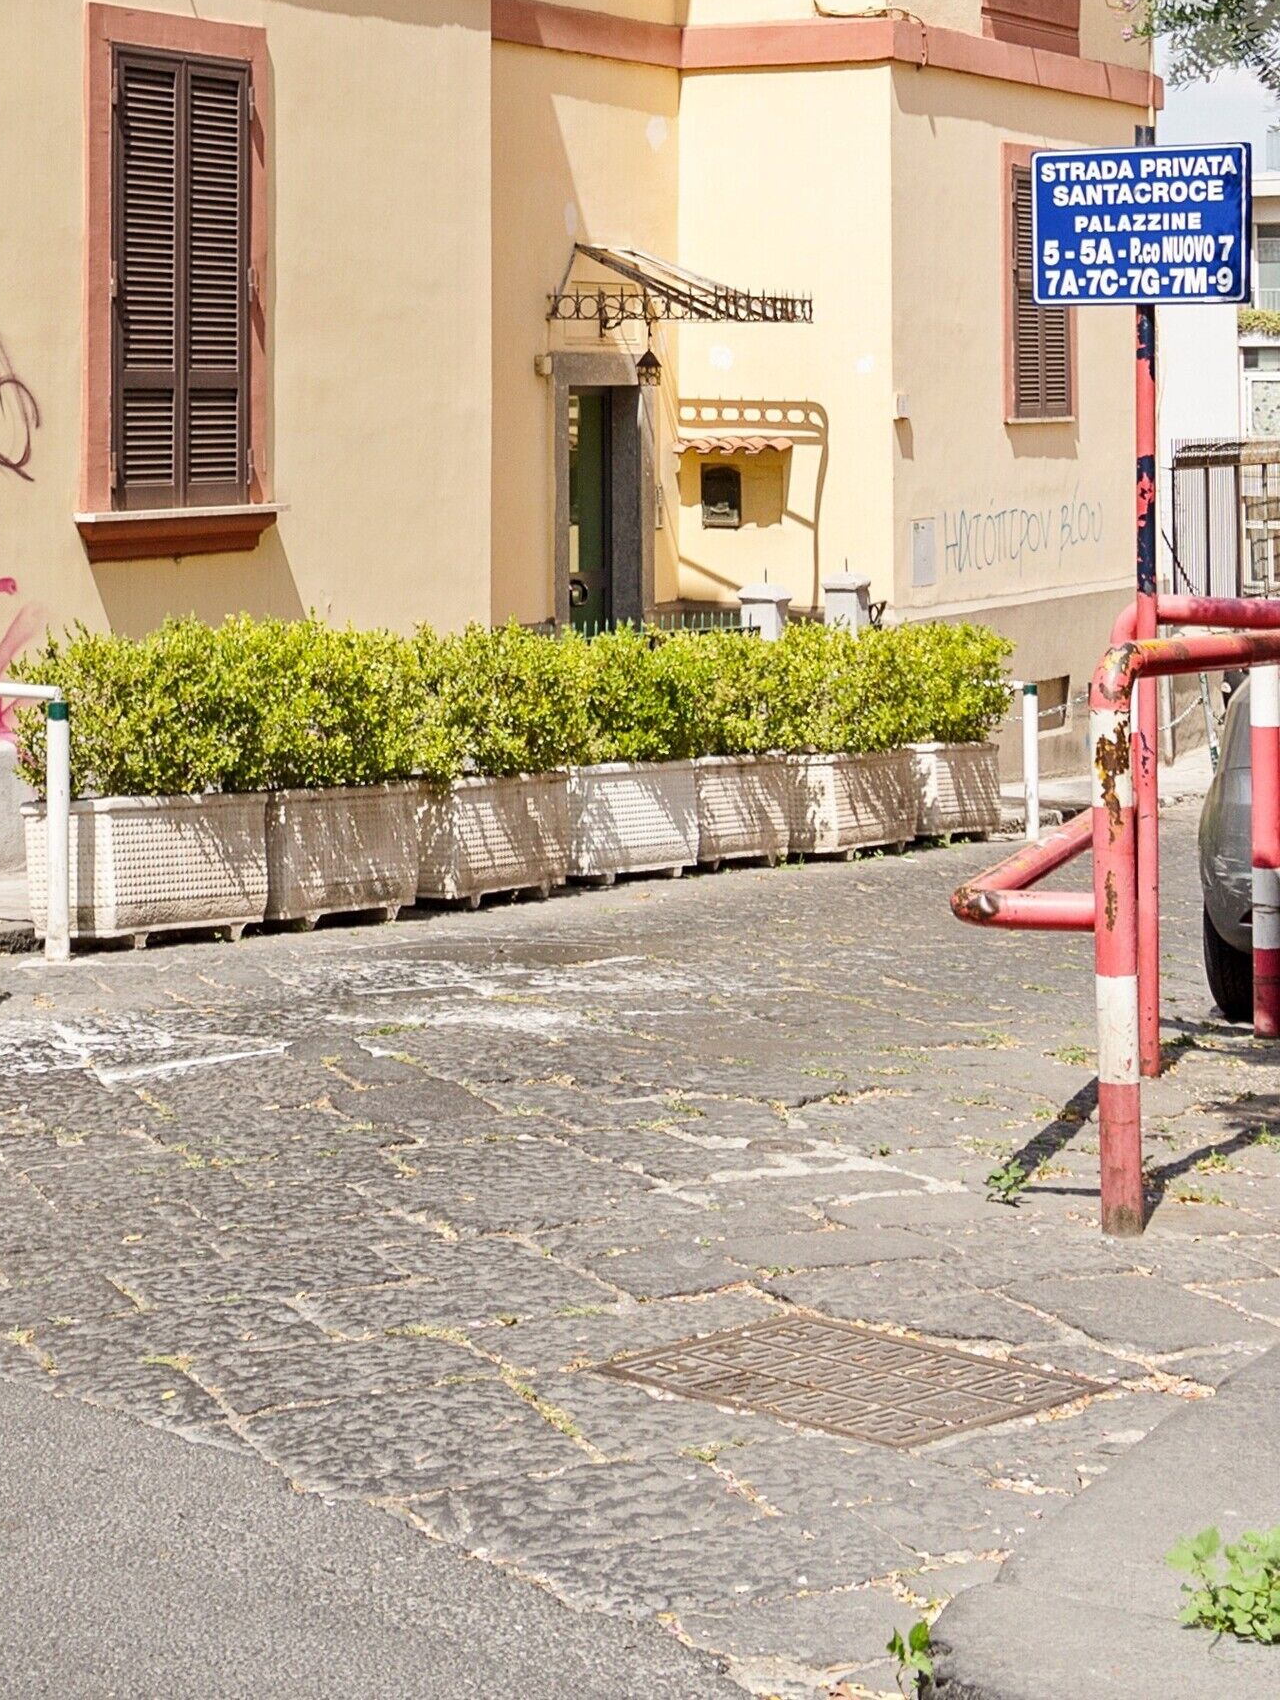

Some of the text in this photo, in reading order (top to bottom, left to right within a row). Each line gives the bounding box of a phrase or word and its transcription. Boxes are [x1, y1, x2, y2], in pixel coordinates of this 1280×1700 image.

[1040, 156, 1237, 183] STRADA PRIVATA
[1053, 180, 1224, 206] SANTACROCE
[1074, 212, 1202, 233] PALAZZINE
[1043, 240, 1059, 265] 5
[1079, 238, 1115, 265] 5A
[1162, 236, 1215, 263] NUOVO
[1218, 235, 1234, 262] 7
